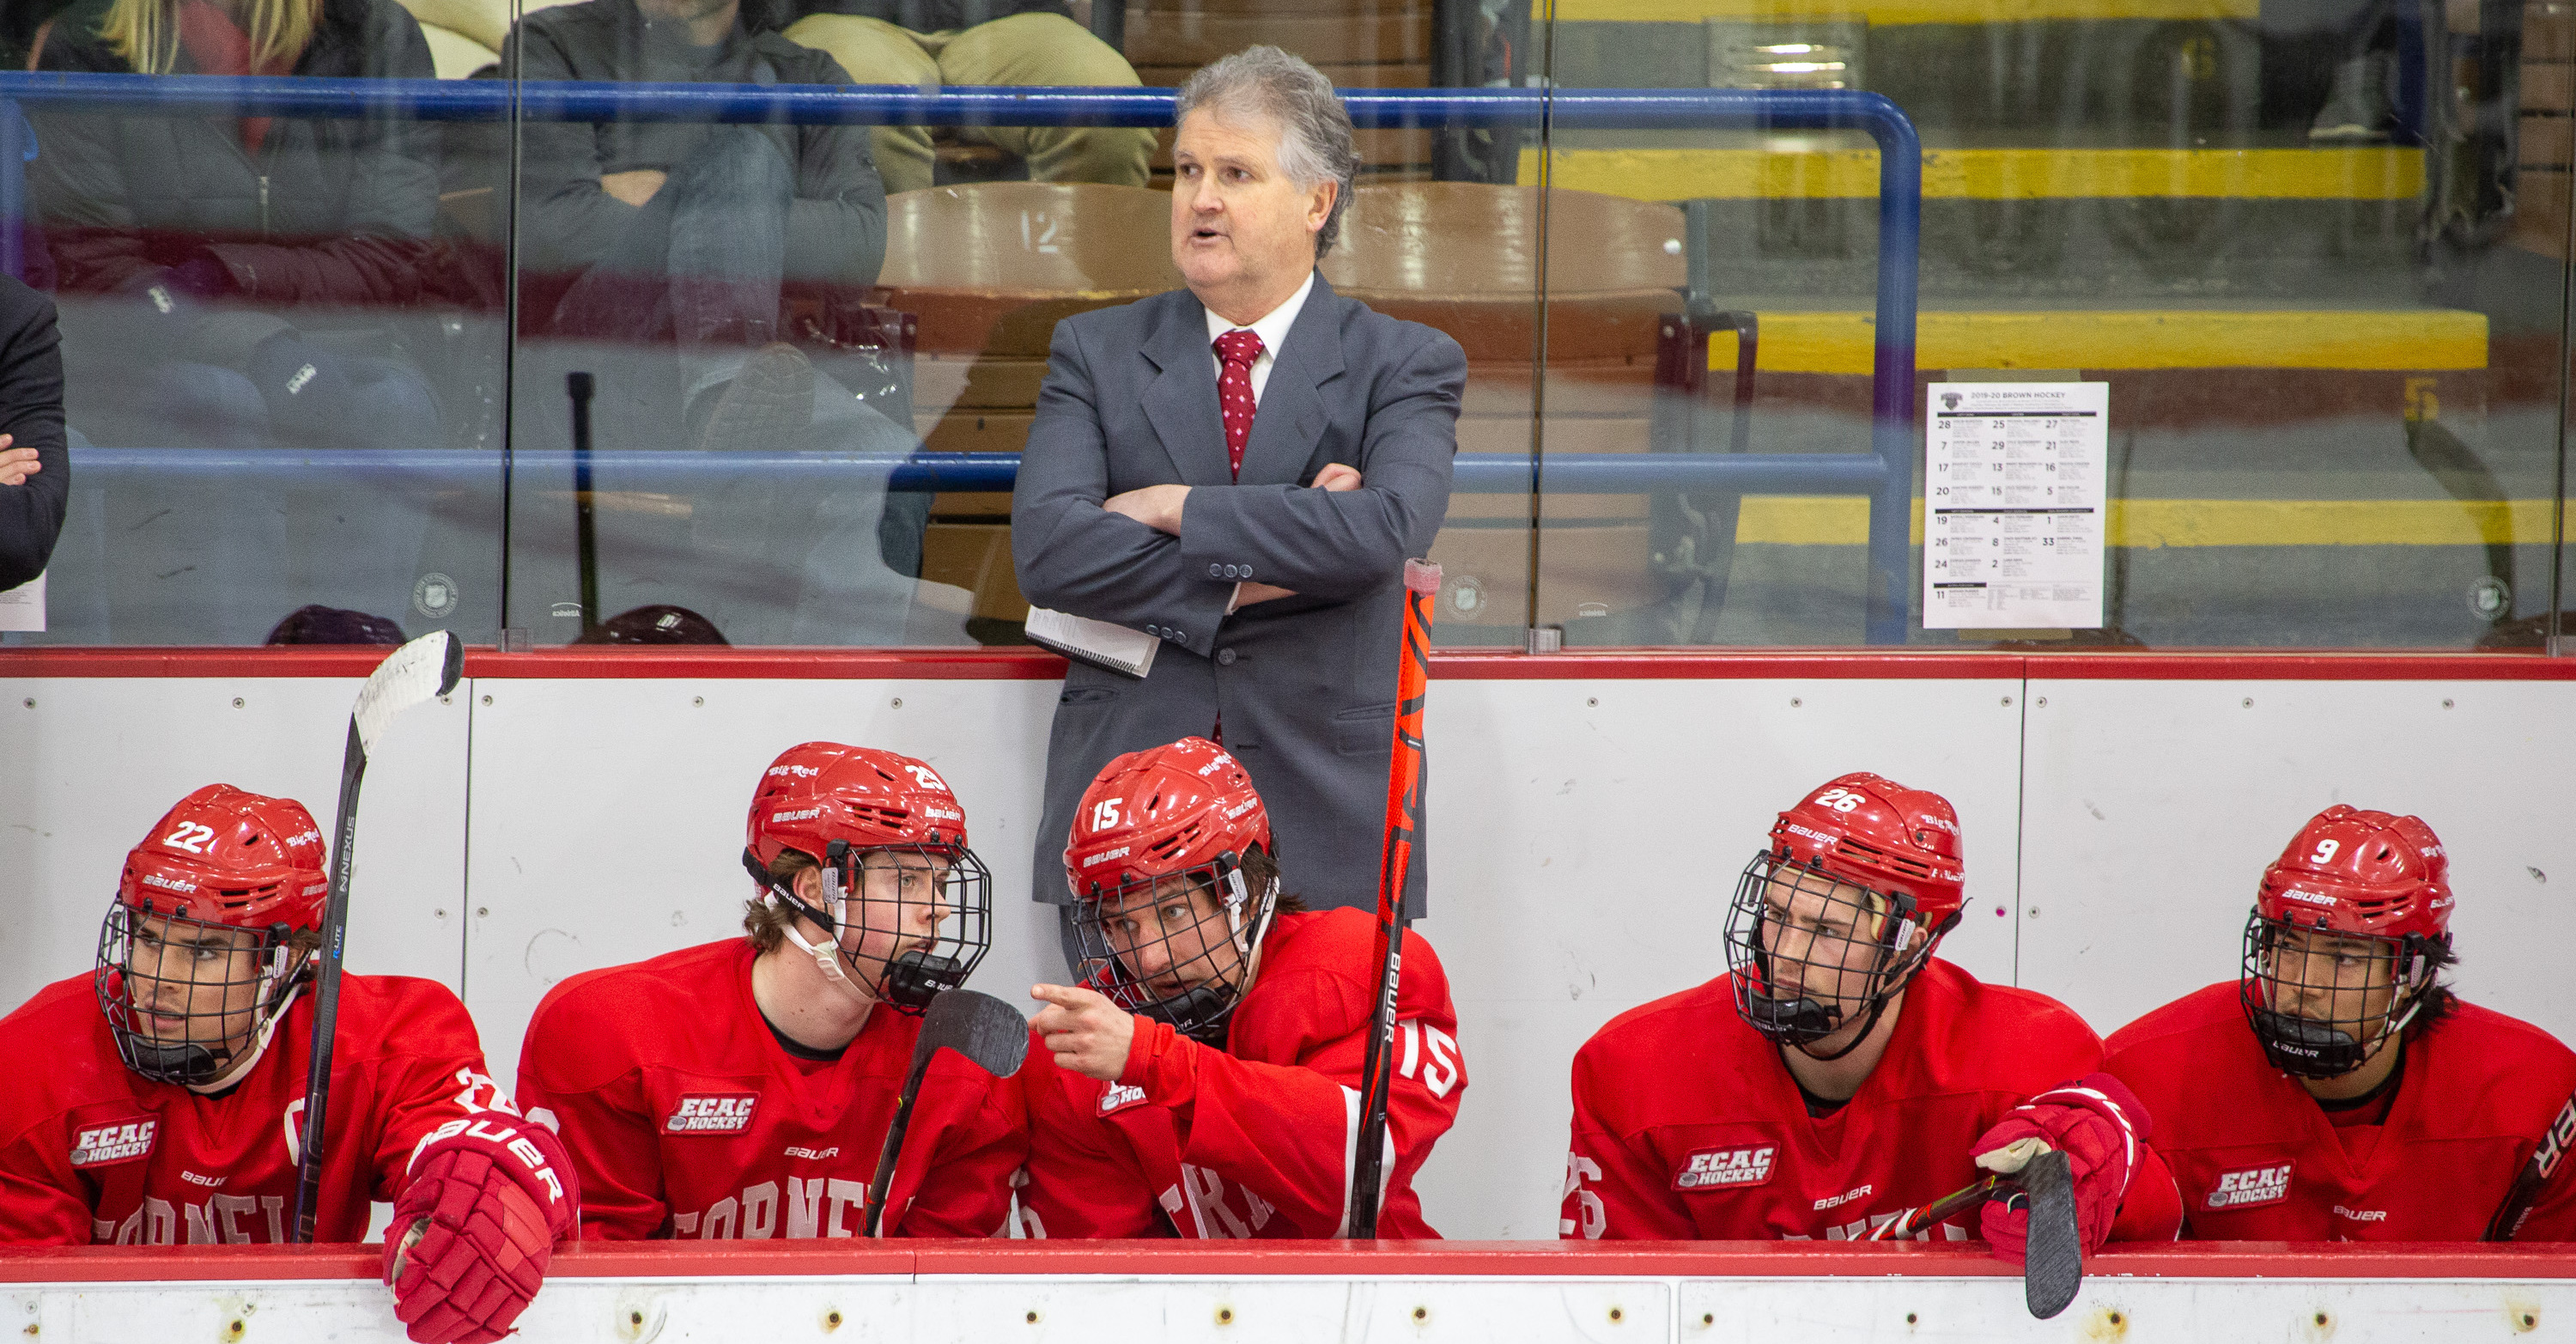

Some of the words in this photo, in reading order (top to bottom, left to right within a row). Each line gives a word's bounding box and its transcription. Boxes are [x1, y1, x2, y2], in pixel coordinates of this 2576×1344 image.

[1021, 210, 1058, 253] 12
[2404, 378, 2439, 422] 5
[1938, 420, 1951, 429] 28
[1992, 420, 2005, 429] 25
[2045, 420, 2058, 429] 27
[1941, 441, 1947, 450] 7
[1991, 441, 2005, 450] 29
[2045, 441, 2057, 450] 21
[1938, 464, 1948, 472] 17
[1992, 463, 2003, 471] 13
[2045, 463, 2056, 471] 16
[1936, 487, 1949, 496] 20
[1991, 487, 2002, 496] 15
[2047, 487, 2053, 496] 5
[1936, 516, 1947, 525] 19
[1993, 516, 1999, 525] 4
[2047, 516, 2051, 525] 1
[1935, 538, 1948, 547] 26
[1992, 538, 1999, 546] 8
[2042, 537, 2055, 546] 33
[1935, 560, 1947, 569] 24
[1992, 560, 1998, 569] 2
[1936, 591, 1945, 599] 11
[769, 765, 789, 776] Big
[791, 764, 819, 777] Red
[1198, 762, 1221, 776] Big
[905, 764, 946, 791] 29
[1814, 788, 1866, 812] 26
[773, 809, 820, 824] BAUER
[925, 806, 962, 822] BAUER
[1092, 797, 1123, 833] 15
[1921, 814, 1945, 830] Big
[163, 821, 215, 854] 22
[286, 835, 307, 848] Big
[1787, 824, 1838, 846] BAUER
[342, 816, 355, 876] NEXUS
[2311, 838, 2341, 864] 9
[1083, 847, 1131, 868] BAUER
[143, 874, 198, 894] BAUER
[773, 883, 805, 911] BAUER
[2281, 889, 2337, 907] BAUER
[1383, 952, 1401, 1043] BAUER
[1399, 1018, 1458, 1100] 15
[679, 1098, 755, 1116] ECAC
[685, 1116, 749, 1130] HOCKEY
[79, 1121, 156, 1150] ECAC
[86, 1140, 152, 1163] HOCKEY
[784, 1146, 840, 1160] BAUER
[1688, 1147, 1774, 1173] ECAC
[180, 1170, 228, 1188] BAU
[1698, 1167, 1768, 1185] HOCKEY
[2217, 1165, 2292, 1193] ECAC
[1814, 1184, 1873, 1211] BAUER
[2227, 1183, 2287, 1206] HOCKEY
[673, 1175, 915, 1240] ORNE
[2333, 1205, 2387, 1222] BAUER
[92, 1192, 284, 1244] ORNEL
